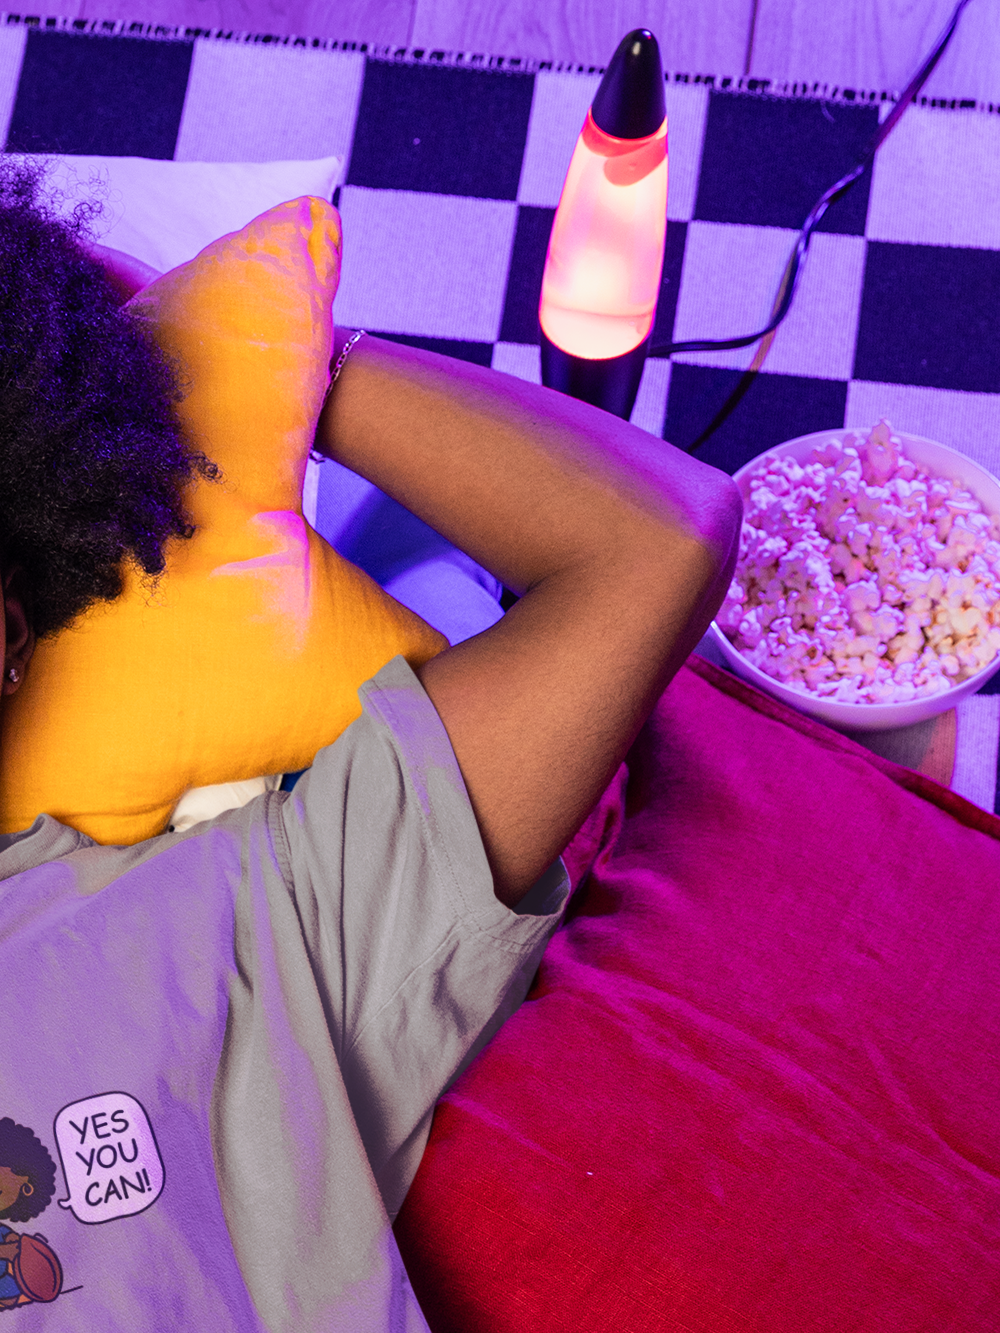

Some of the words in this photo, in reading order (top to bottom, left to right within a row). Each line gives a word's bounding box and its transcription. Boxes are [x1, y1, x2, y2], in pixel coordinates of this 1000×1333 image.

[68, 1109, 129, 1145] YES
[75, 1138, 138, 1176] YOU
[85, 1168, 152, 1206] CAN!
